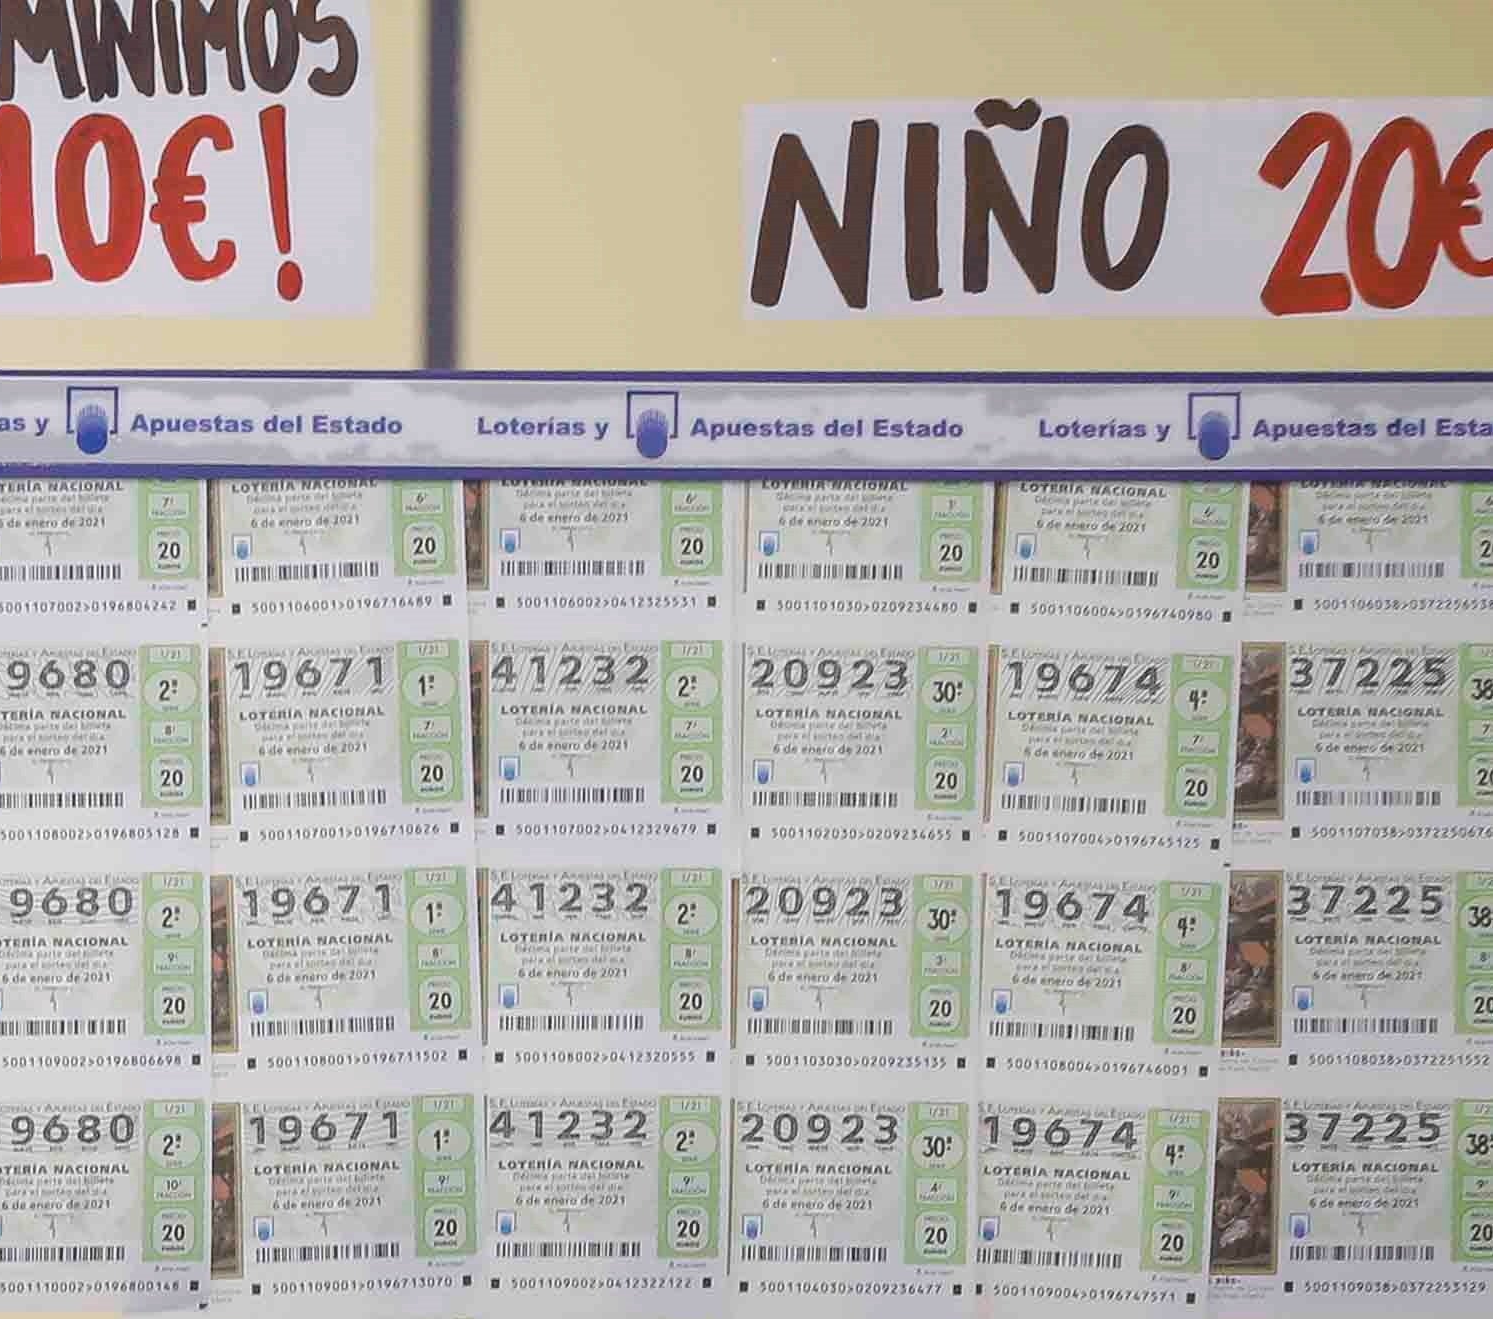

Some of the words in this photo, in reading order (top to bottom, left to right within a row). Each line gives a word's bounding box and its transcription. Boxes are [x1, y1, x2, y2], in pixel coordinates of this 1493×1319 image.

[750, 98, 1170, 309] NIÑO
[35, 418, 49, 437] y
[129, 413, 254, 437] Apuestas
[263, 414, 303, 434] del
[312, 415, 403, 435] Estado
[233, 655, 389, 690] 19671
[491, 654, 652, 689] 41232
[750, 657, 911, 690] 20923
[1004, 660, 1163, 695] 19674
[1289, 655, 1449, 689] 37225
